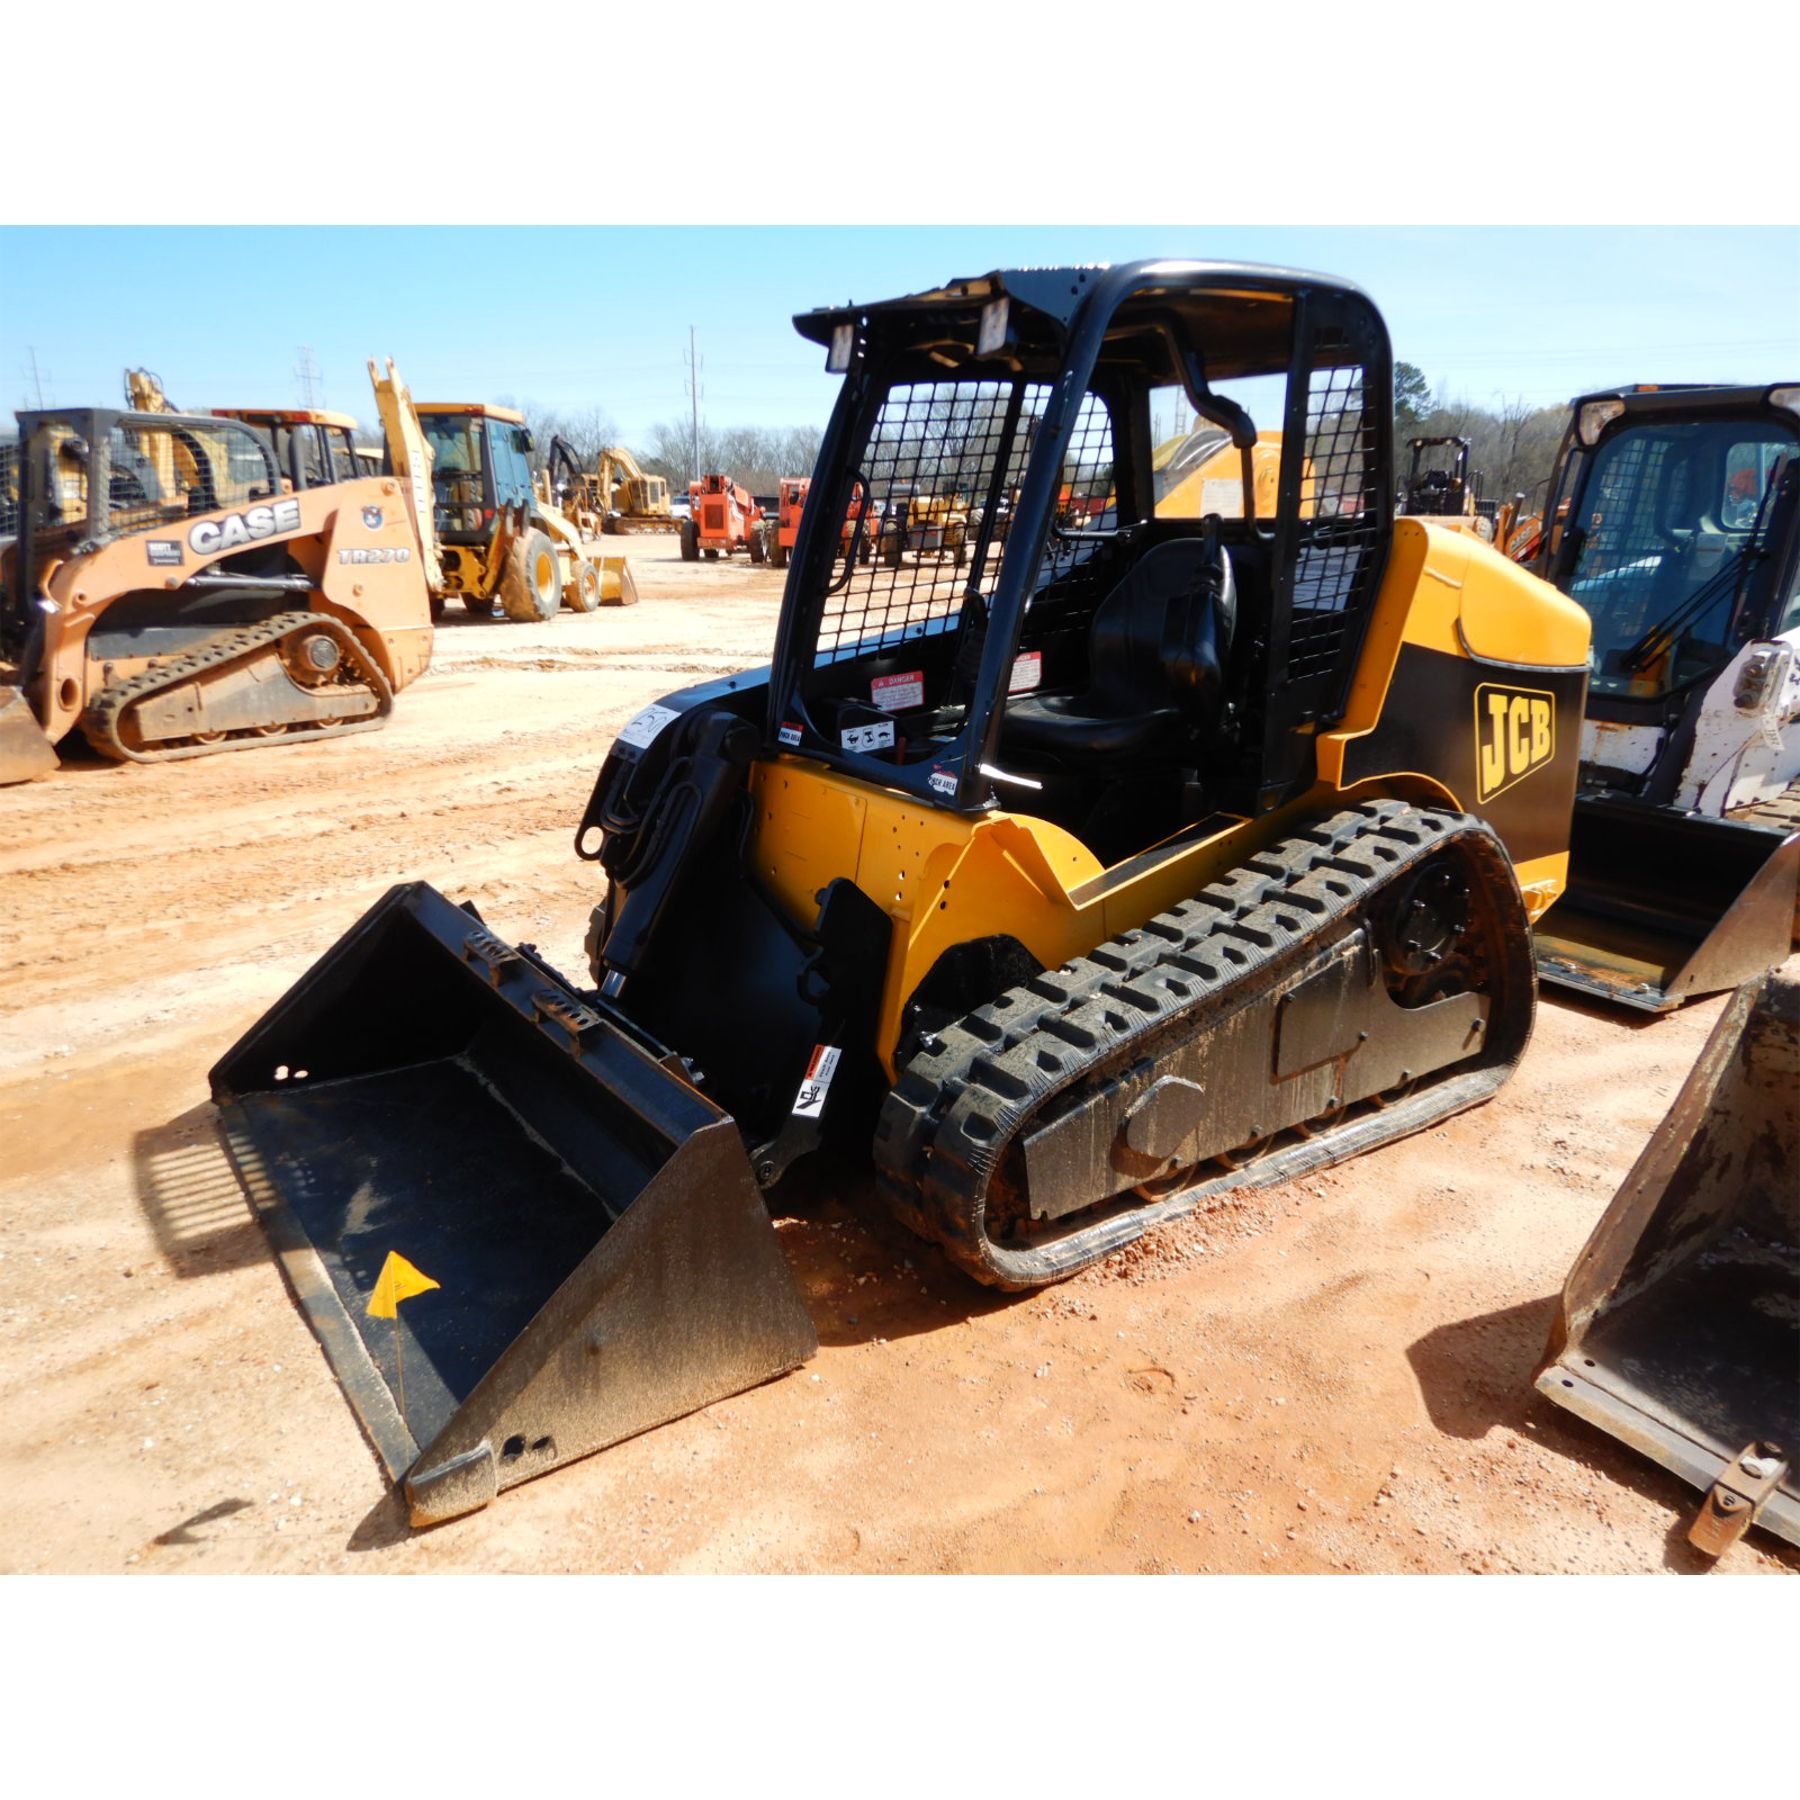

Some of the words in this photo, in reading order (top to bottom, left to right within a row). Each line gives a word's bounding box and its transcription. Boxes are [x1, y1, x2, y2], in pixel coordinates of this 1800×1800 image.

[189, 498, 301, 555] CASE
[337, 548, 410, 564] TR270
[889, 674, 914, 685] DANGER
[1482, 693, 1551, 794] JCB
[942, 780, 955, 790] AREA
